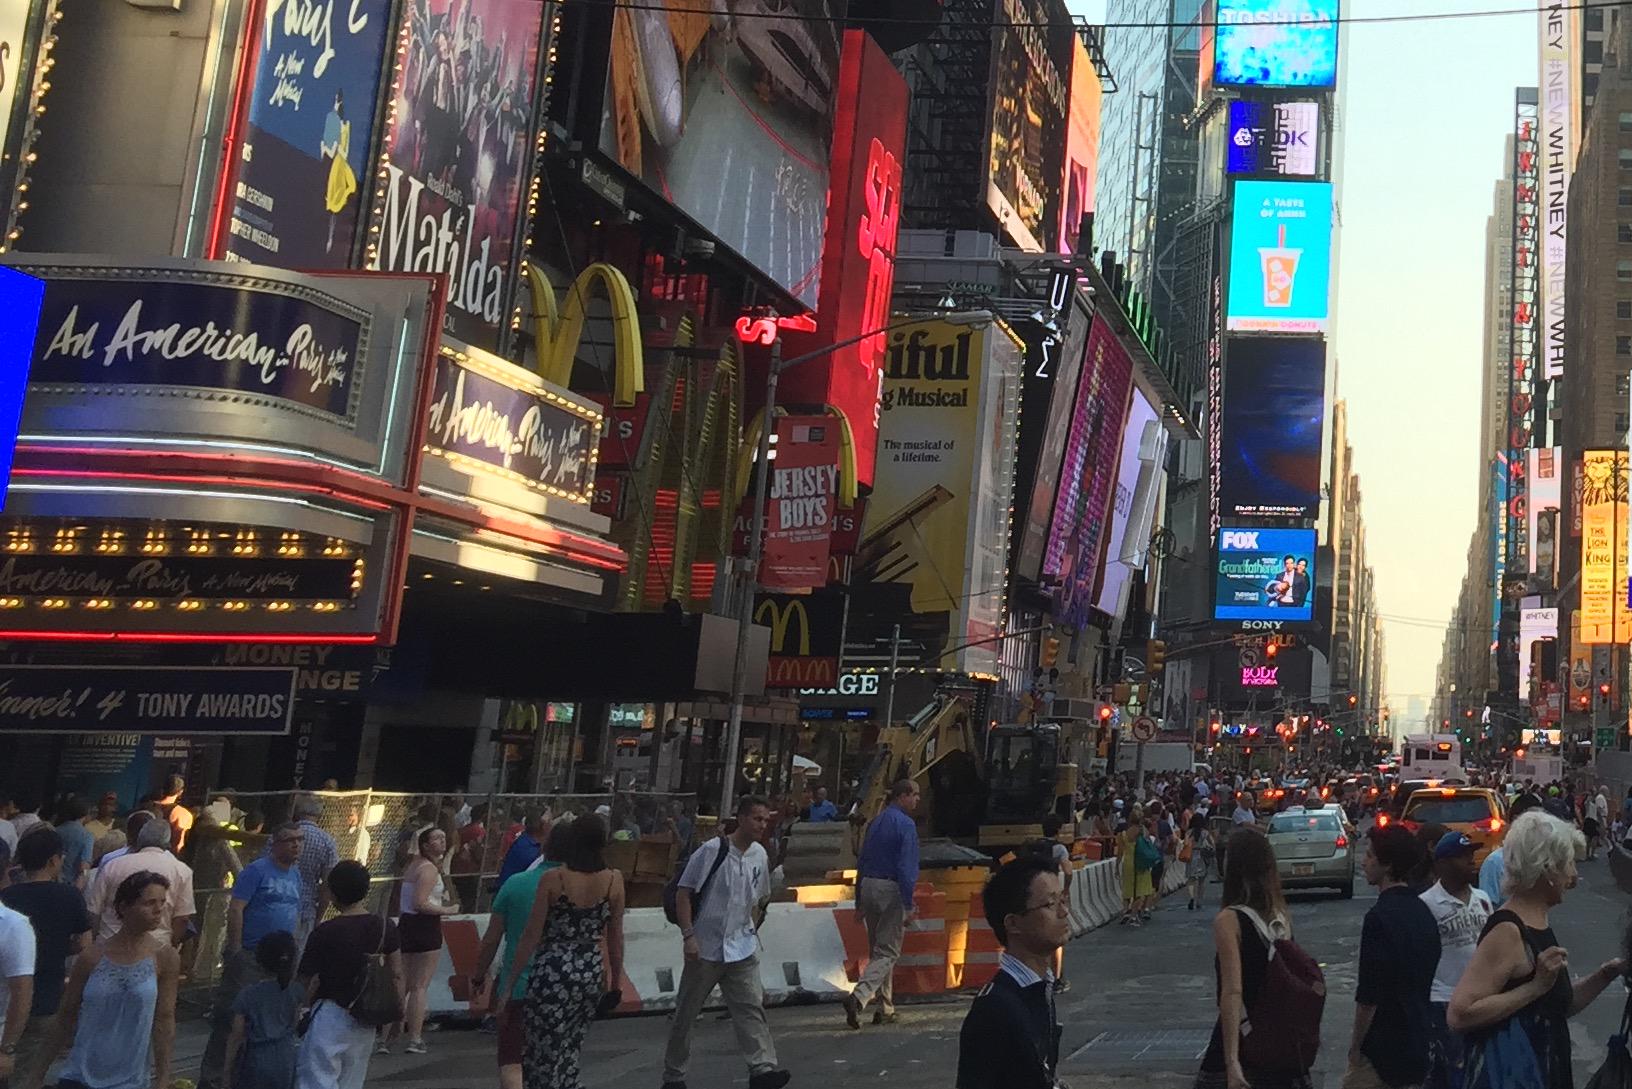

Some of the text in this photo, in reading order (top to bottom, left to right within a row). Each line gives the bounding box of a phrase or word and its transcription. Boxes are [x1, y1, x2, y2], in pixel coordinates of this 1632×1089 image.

[371, 164, 502, 325] Matilda
[42, 304, 100, 361] An
[103, 299, 278, 385] American
[286, 323, 326, 394] Paris
[896, 387, 968, 408] Musical
[442, 369, 514, 468] American
[518, 405, 555, 480] Paris
[770, 463, 838, 499] JERSEY
[780, 496, 828, 530] BOYS
[1222, 531, 1260, 550] FOX
[127, 559, 193, 597] Paris
[1242, 620, 1284, 630] SONY
[223, 645, 333, 667] MONEY
[1242, 666, 1279, 679] BODY
[137, 692, 193, 719] TONY
[195, 692, 286, 719] AWARDS
